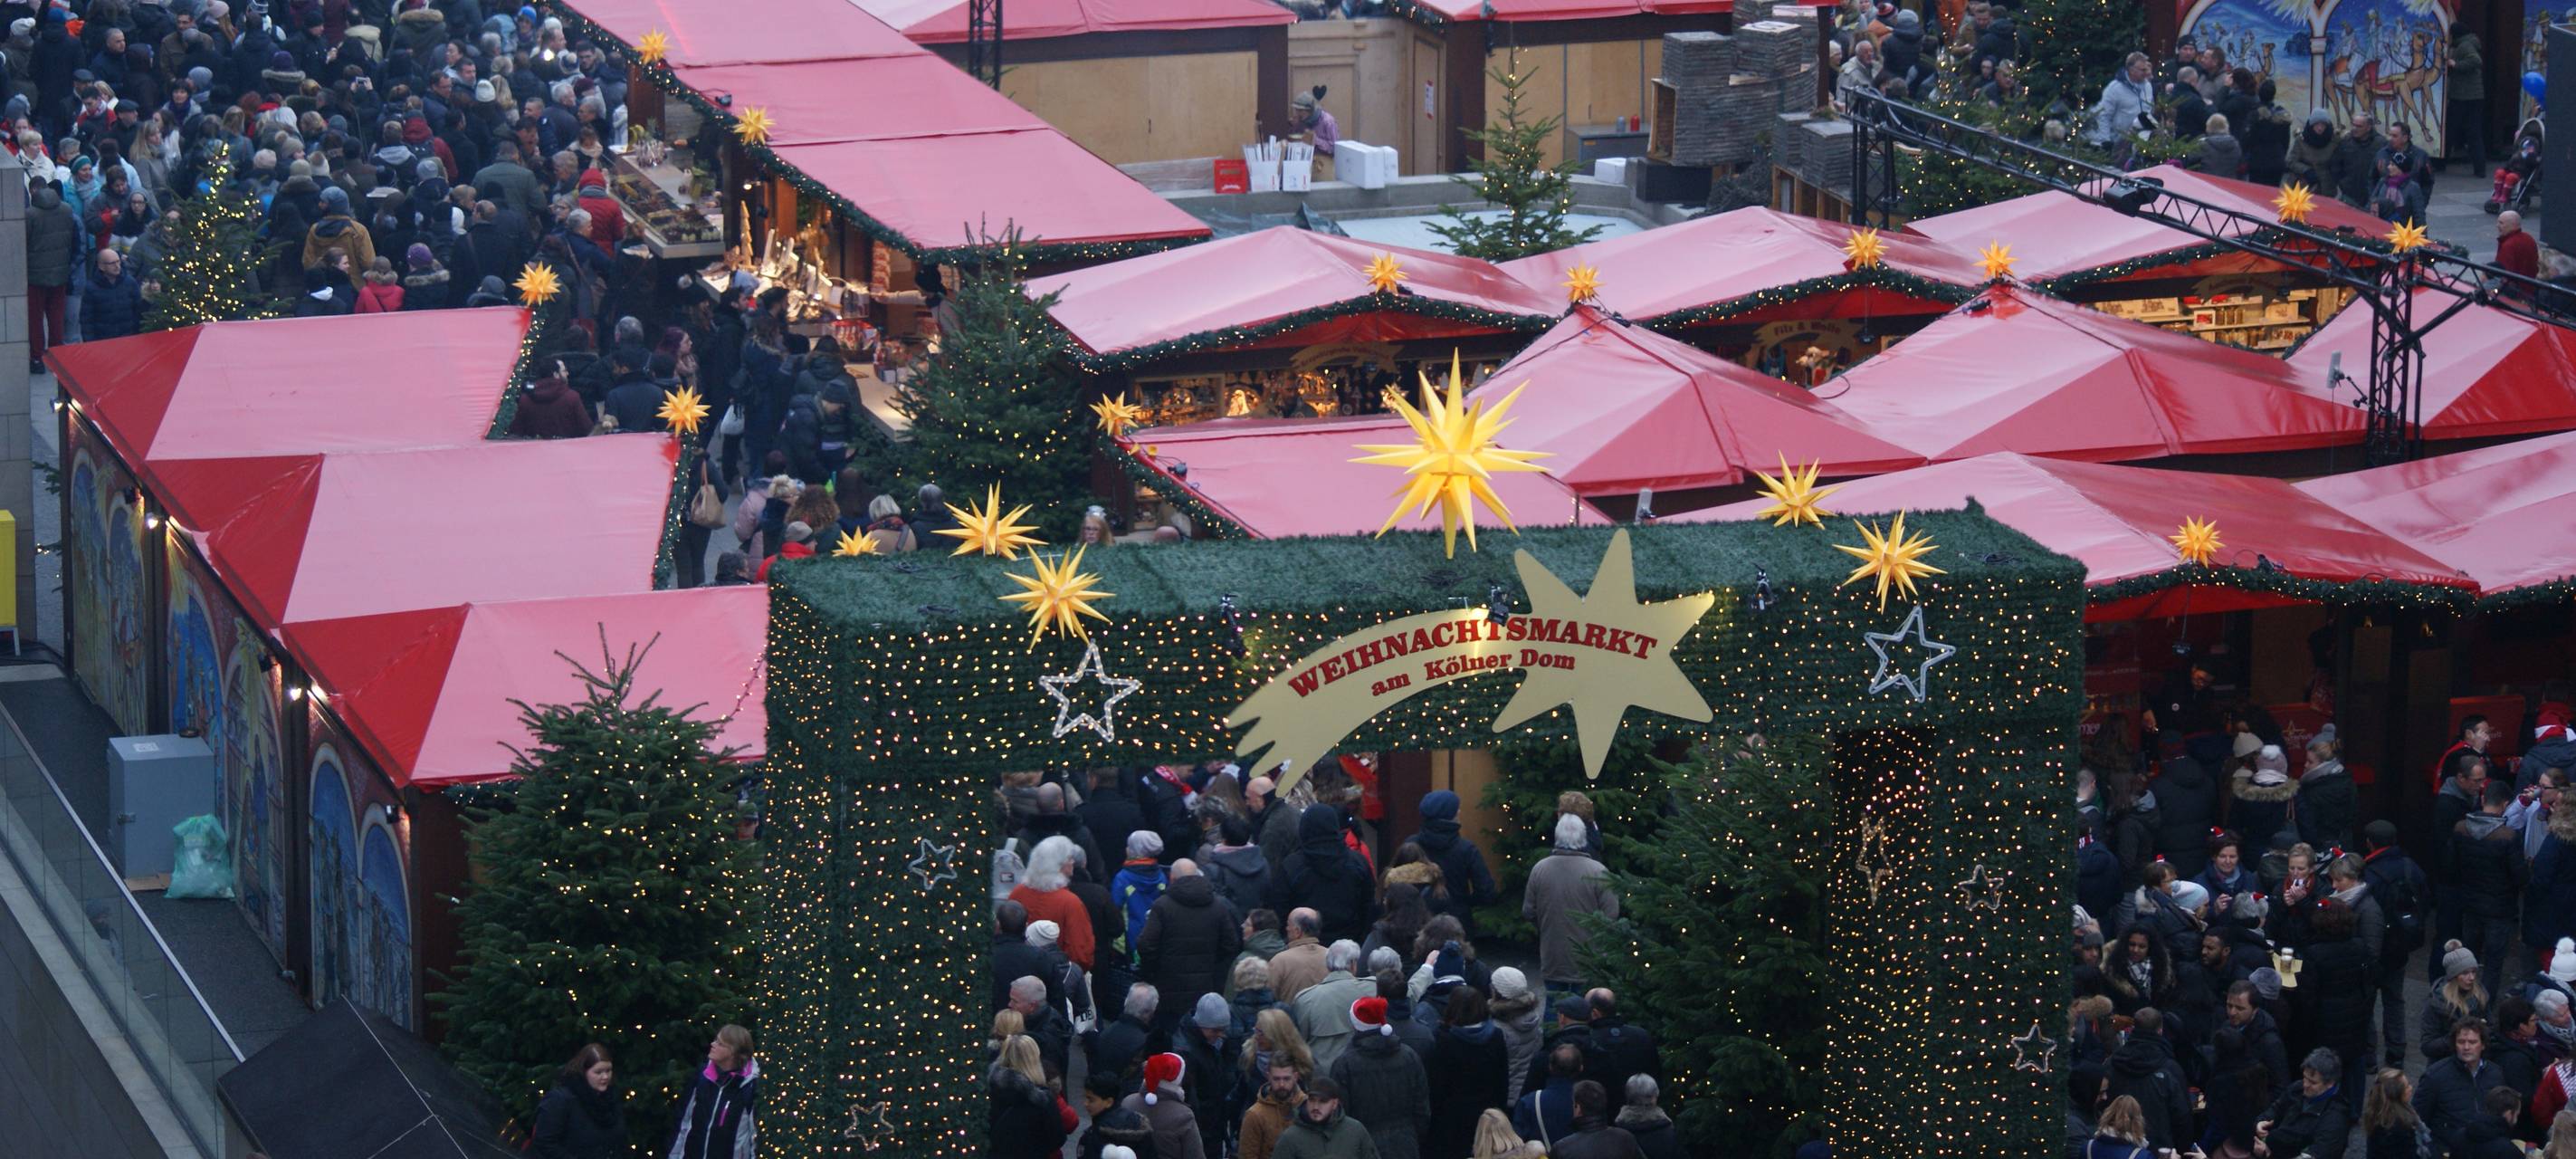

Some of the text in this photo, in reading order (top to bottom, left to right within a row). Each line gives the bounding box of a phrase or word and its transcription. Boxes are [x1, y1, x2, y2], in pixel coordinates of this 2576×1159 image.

[1287, 615, 1657, 698] WEIHNACHTSMARKT
[1370, 648, 1576, 696] am Kölner Dom
